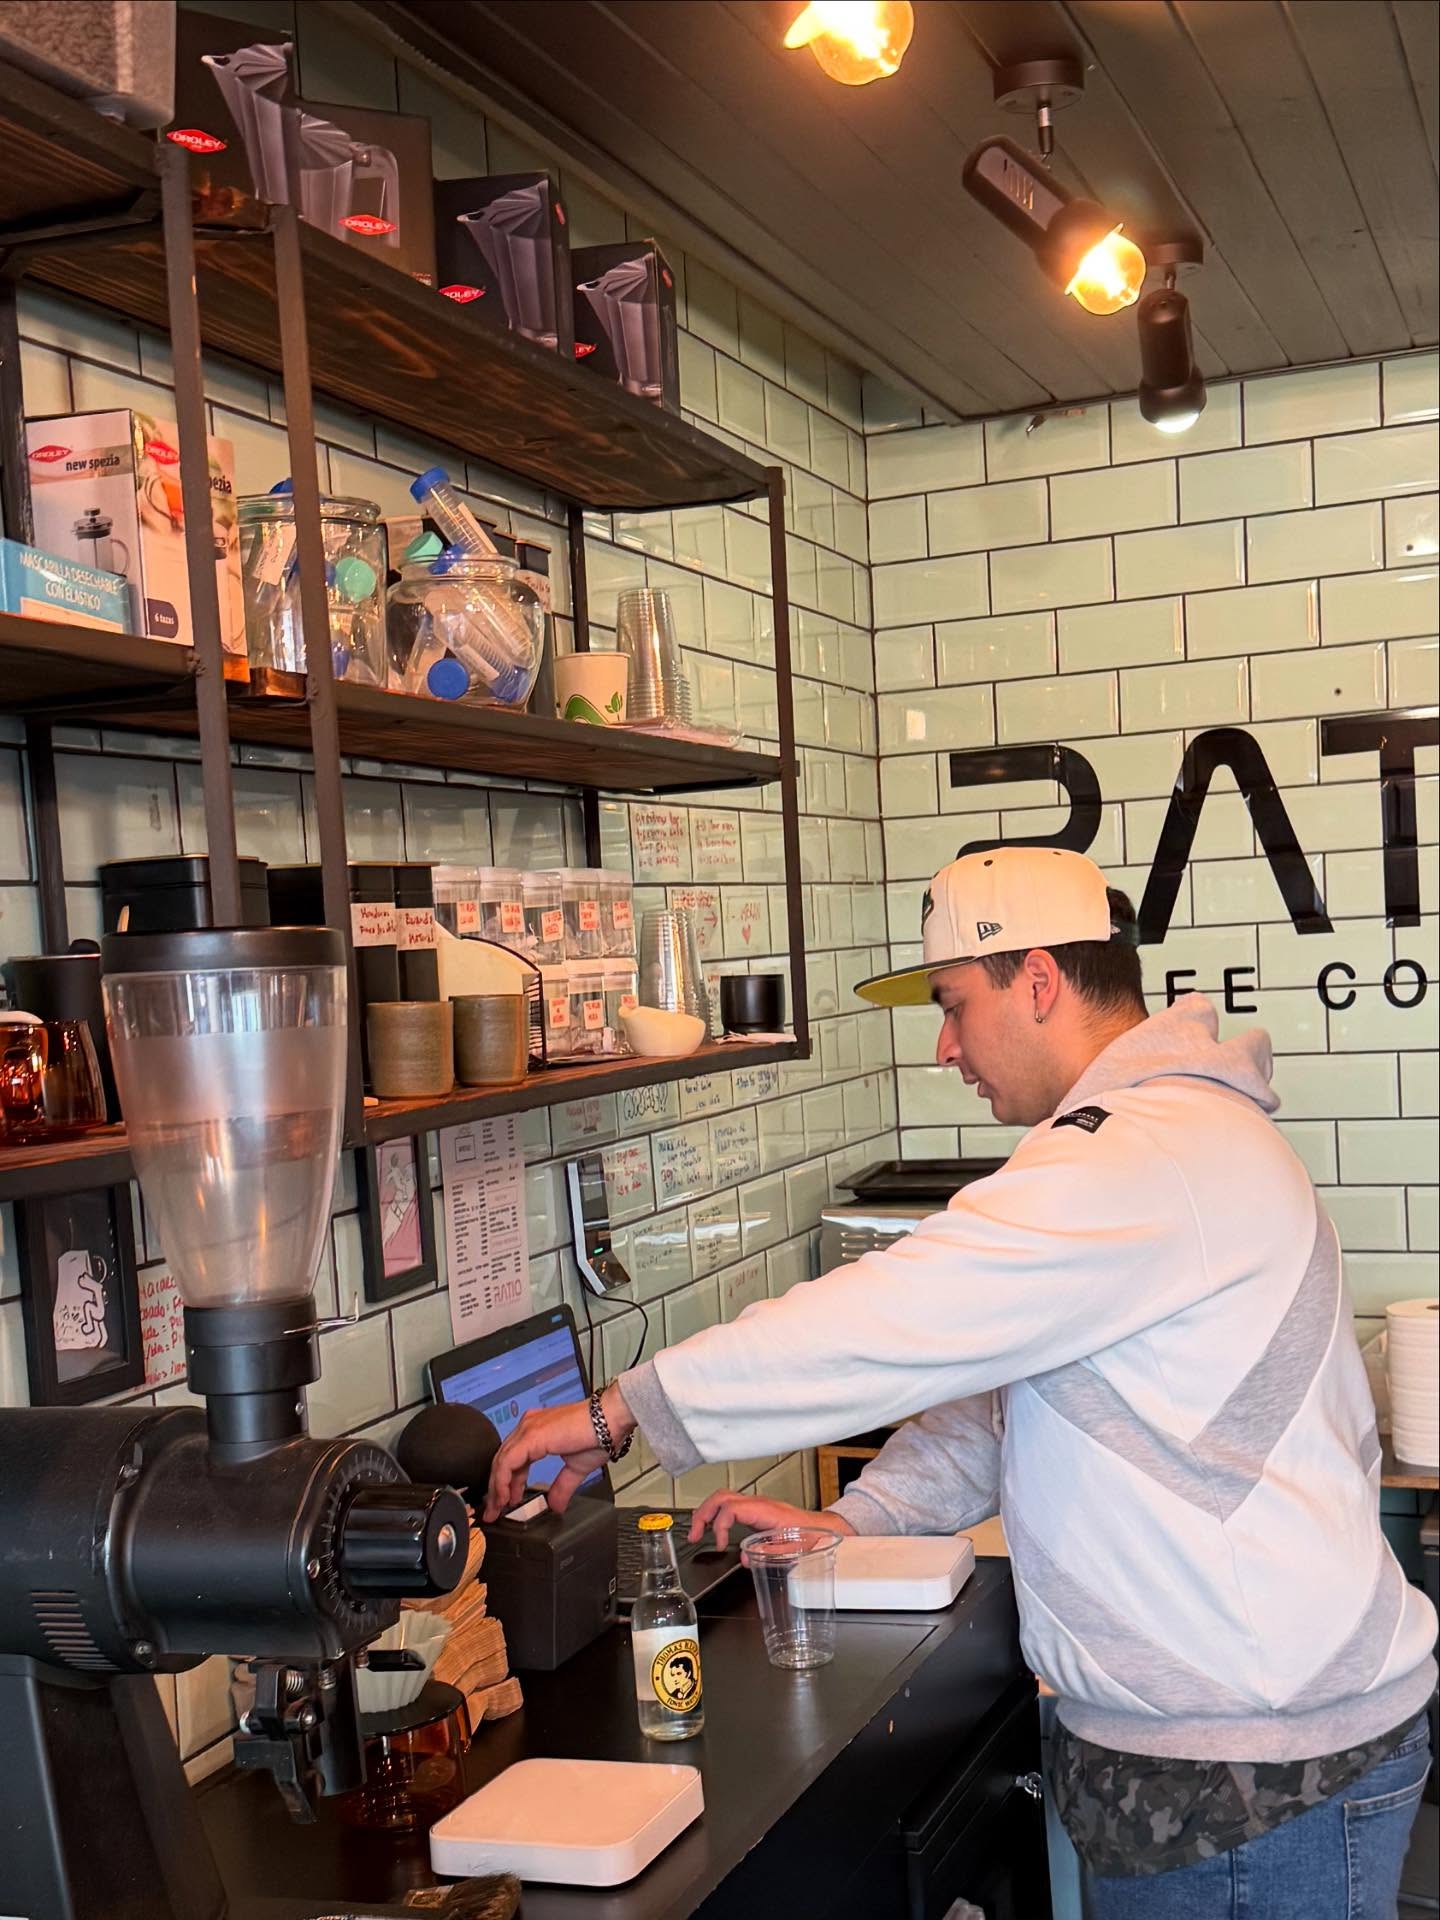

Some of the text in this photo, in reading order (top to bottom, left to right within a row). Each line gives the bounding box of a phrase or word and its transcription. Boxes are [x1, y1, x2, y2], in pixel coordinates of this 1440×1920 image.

[65, 454, 120, 472] new spezia
[154, 612, 160, 623] 6
[1317, 959, 1428, 1011] CO
[494, 1279, 522, 1303] RATIO
[656, 1641, 683, 1666] THOMAS
